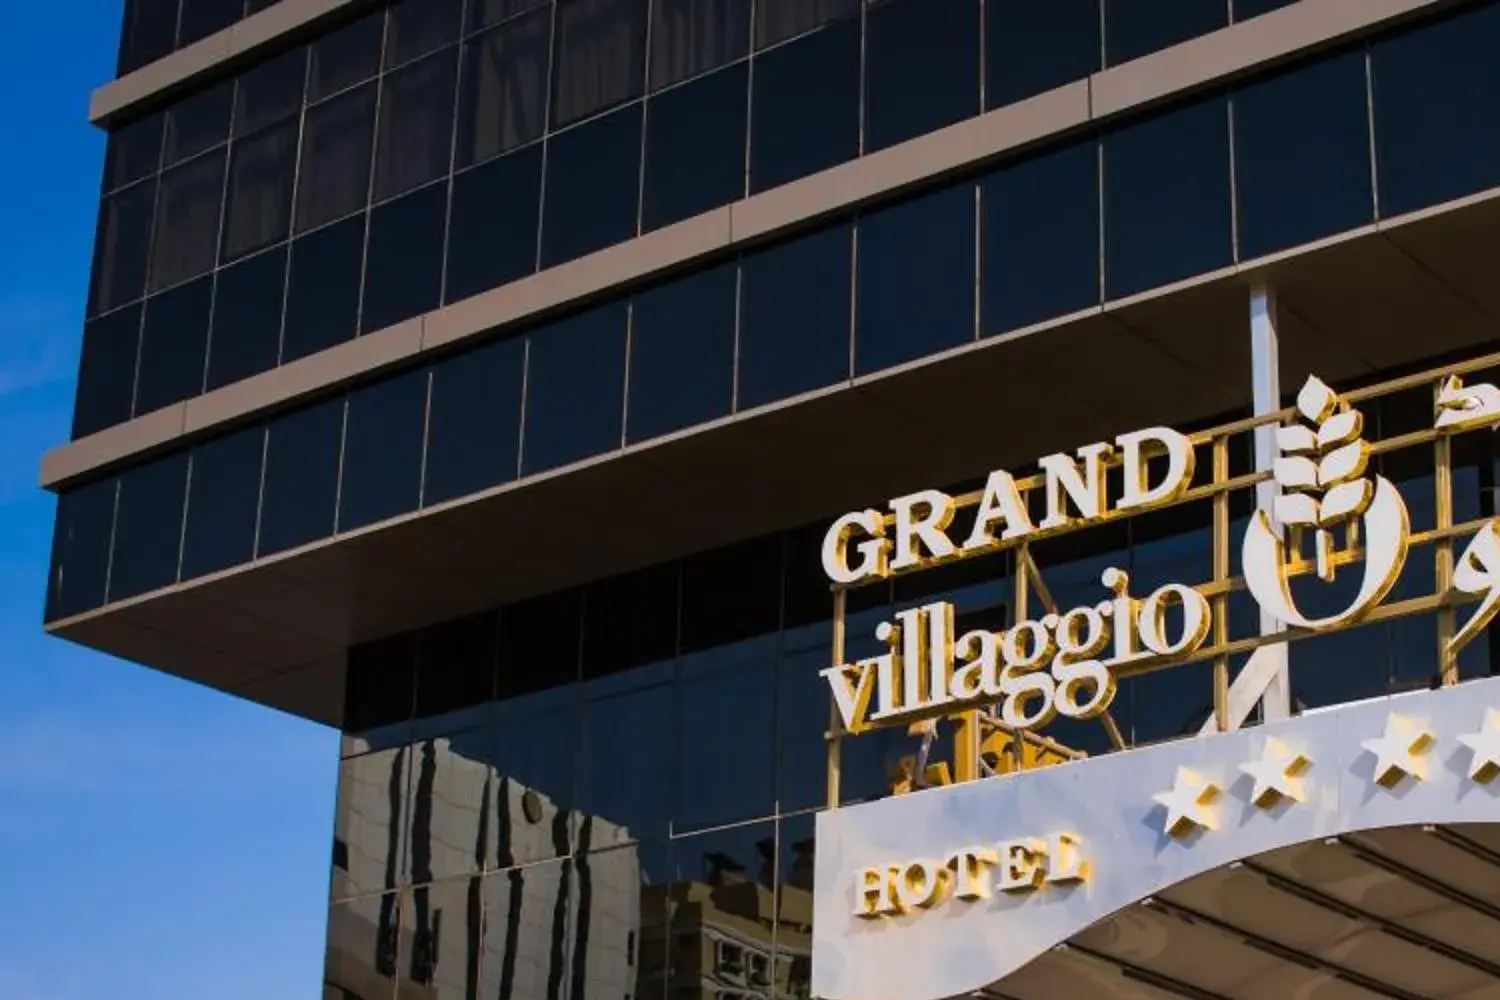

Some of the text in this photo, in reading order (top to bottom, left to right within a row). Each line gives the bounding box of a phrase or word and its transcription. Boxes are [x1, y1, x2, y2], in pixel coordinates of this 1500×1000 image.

[821, 426, 1196, 584] GRAND
[819, 566, 1212, 732] villaggio
[852, 831, 1094, 920] HOTEL
